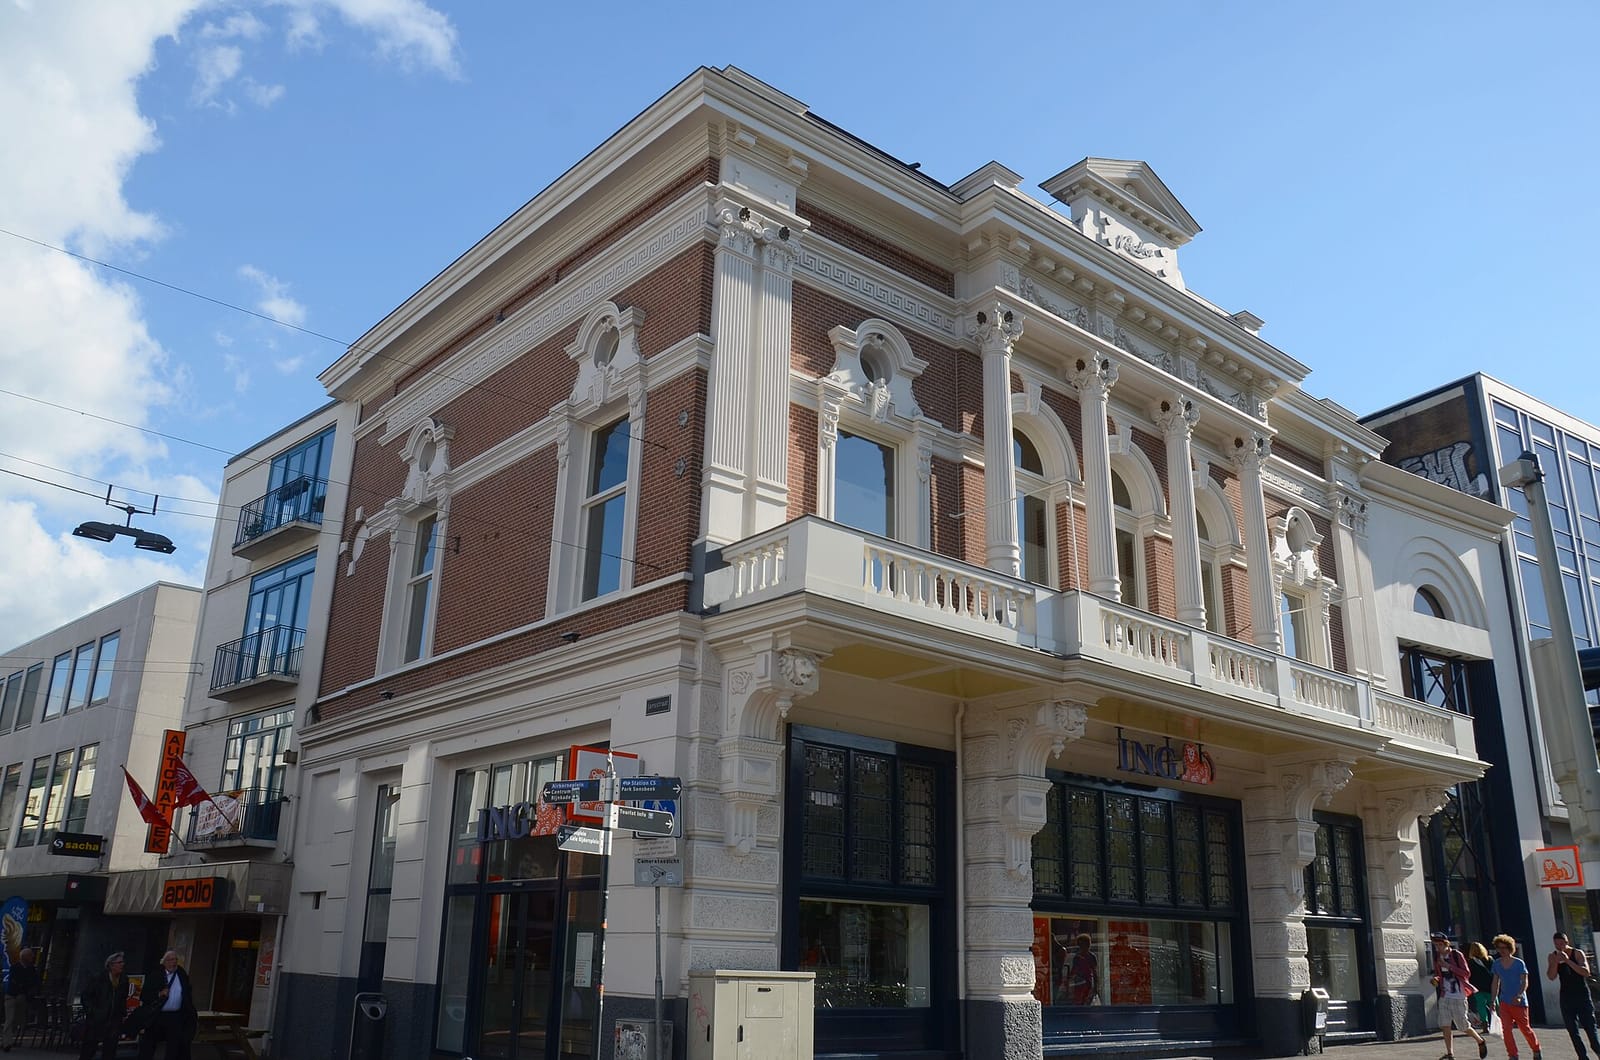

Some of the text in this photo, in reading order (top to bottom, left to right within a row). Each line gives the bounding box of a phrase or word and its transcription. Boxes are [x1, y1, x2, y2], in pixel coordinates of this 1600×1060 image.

[1118, 738, 1178, 779] ING
[152, 735, 180, 848] AUTOMATEK
[477, 802, 530, 842] ING
[619, 808, 636, 816] Tourist
[65, 841, 99, 852] sacha
[165, 880, 212, 907] apollo
